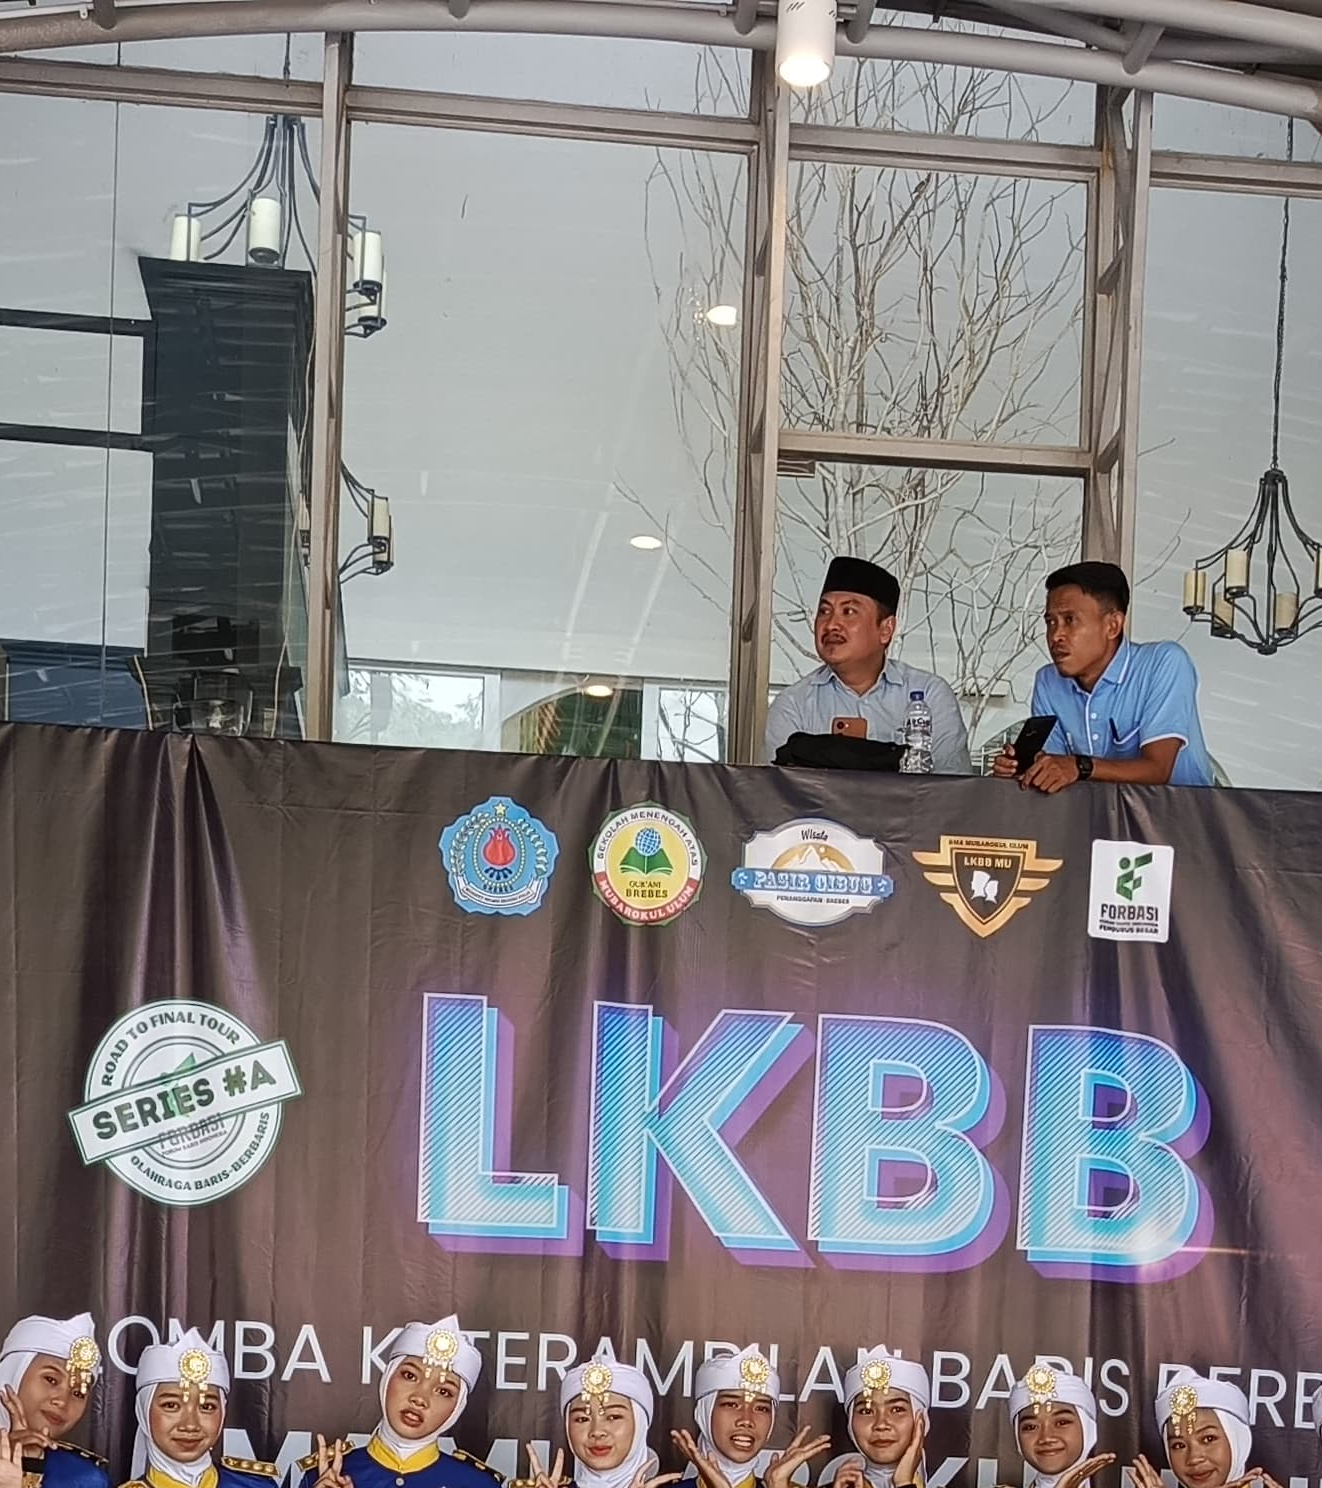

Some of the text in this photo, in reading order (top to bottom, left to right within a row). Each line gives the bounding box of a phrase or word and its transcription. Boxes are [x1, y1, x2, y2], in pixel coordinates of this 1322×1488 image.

[597, 811, 698, 866] SEKOLAH MENENGAH ATAS
[964, 856, 1012, 869] LKBB MU
[599, 879, 695, 920] MUBAROKUL ULUM
[625, 888, 668, 898] BREBES
[753, 870, 812, 892] PASIR
[1100, 903, 1159, 921] FORBASI
[101, 1011, 241, 1086] ROAD TO FINAL TOUR
[92, 1059, 277, 1140] SERIES #A
[130, 1111, 270, 1191] OLAHRAGA BARIS-BERBARIS
[418, 992, 1211, 1280] LKBB
[97, 1315, 333, 1383] OBA
